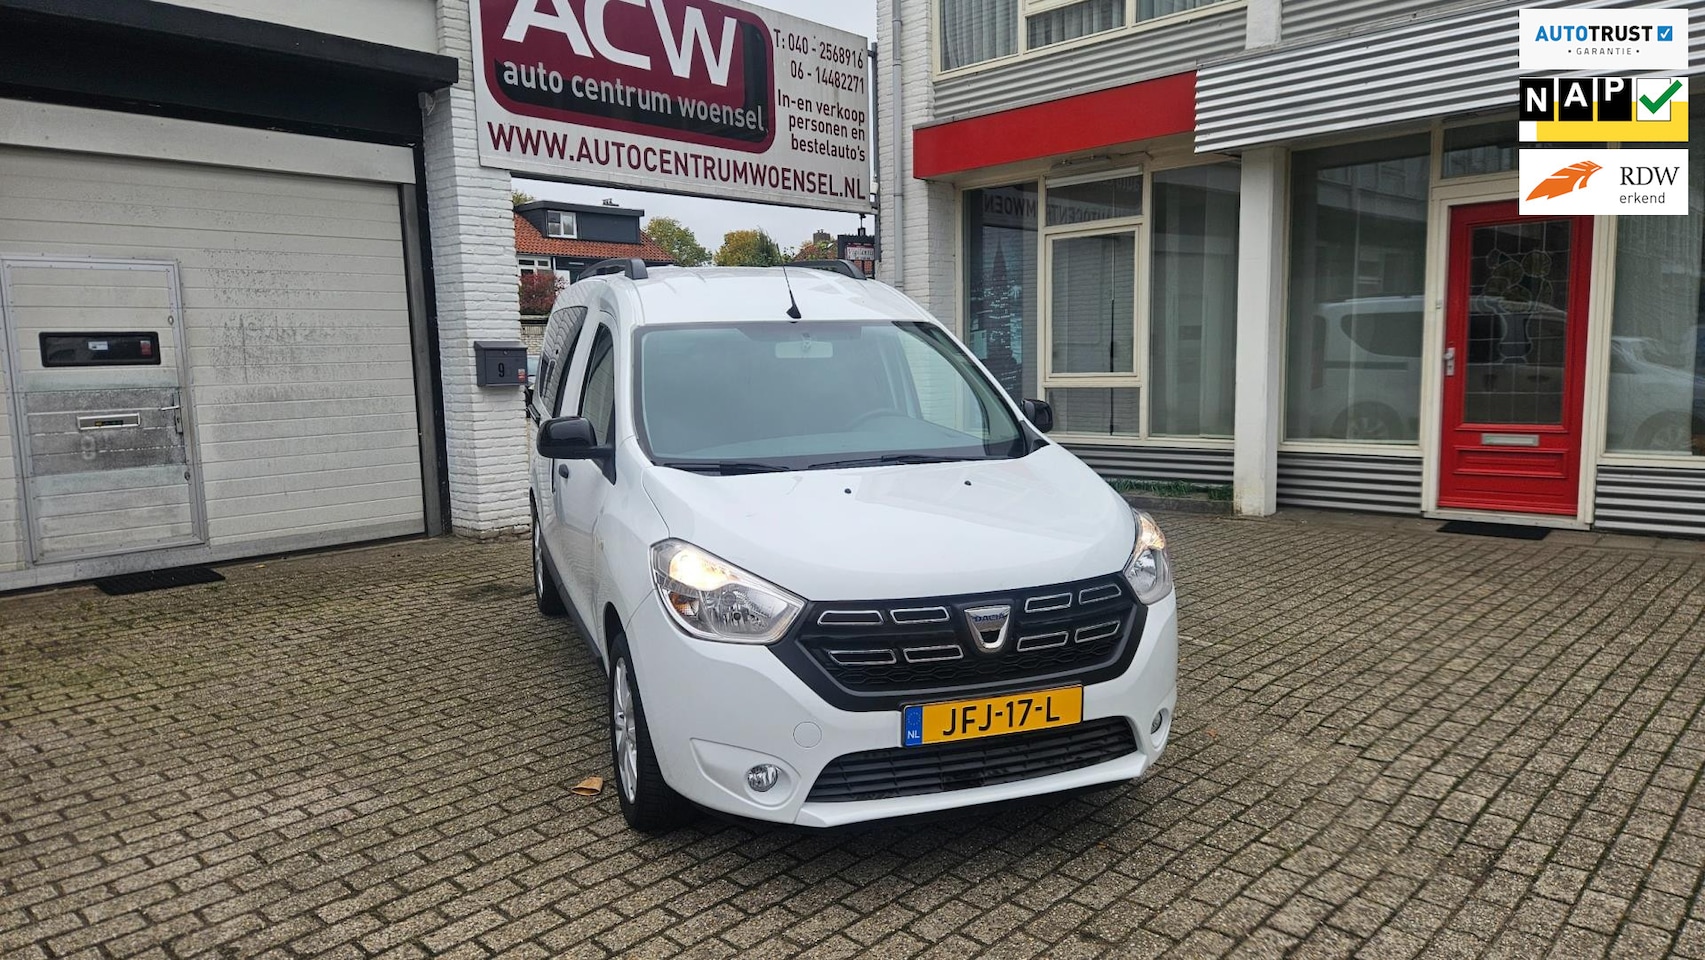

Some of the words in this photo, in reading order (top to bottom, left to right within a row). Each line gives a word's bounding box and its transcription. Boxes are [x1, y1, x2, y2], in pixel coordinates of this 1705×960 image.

[502, 0, 737, 87] ACW
[773, 29, 786, 48] T:
[788, 33, 809, 55] 040
[819, 42, 864, 69] 2568916
[790, 61, 804, 80] 06
[816, 66, 865, 94] 14482271
[503, 60, 564, 94] auto
[571, 75, 672, 115] centrum
[678, 95, 765, 132] woensel
[778, 89, 813, 113] In-en
[816, 102, 866, 125] verkoop
[789, 114, 848, 138] personen
[851, 127, 865, 141] en
[487, 121, 866, 200] WWW.AUTOCENTRUMWOENSEL.NL
[791, 134, 866, 162] bestelauto's
[498, 362, 505, 378] 9
[942, 696, 1061, 737] JFJ-17-L
[907, 730, 920, 740] NL
